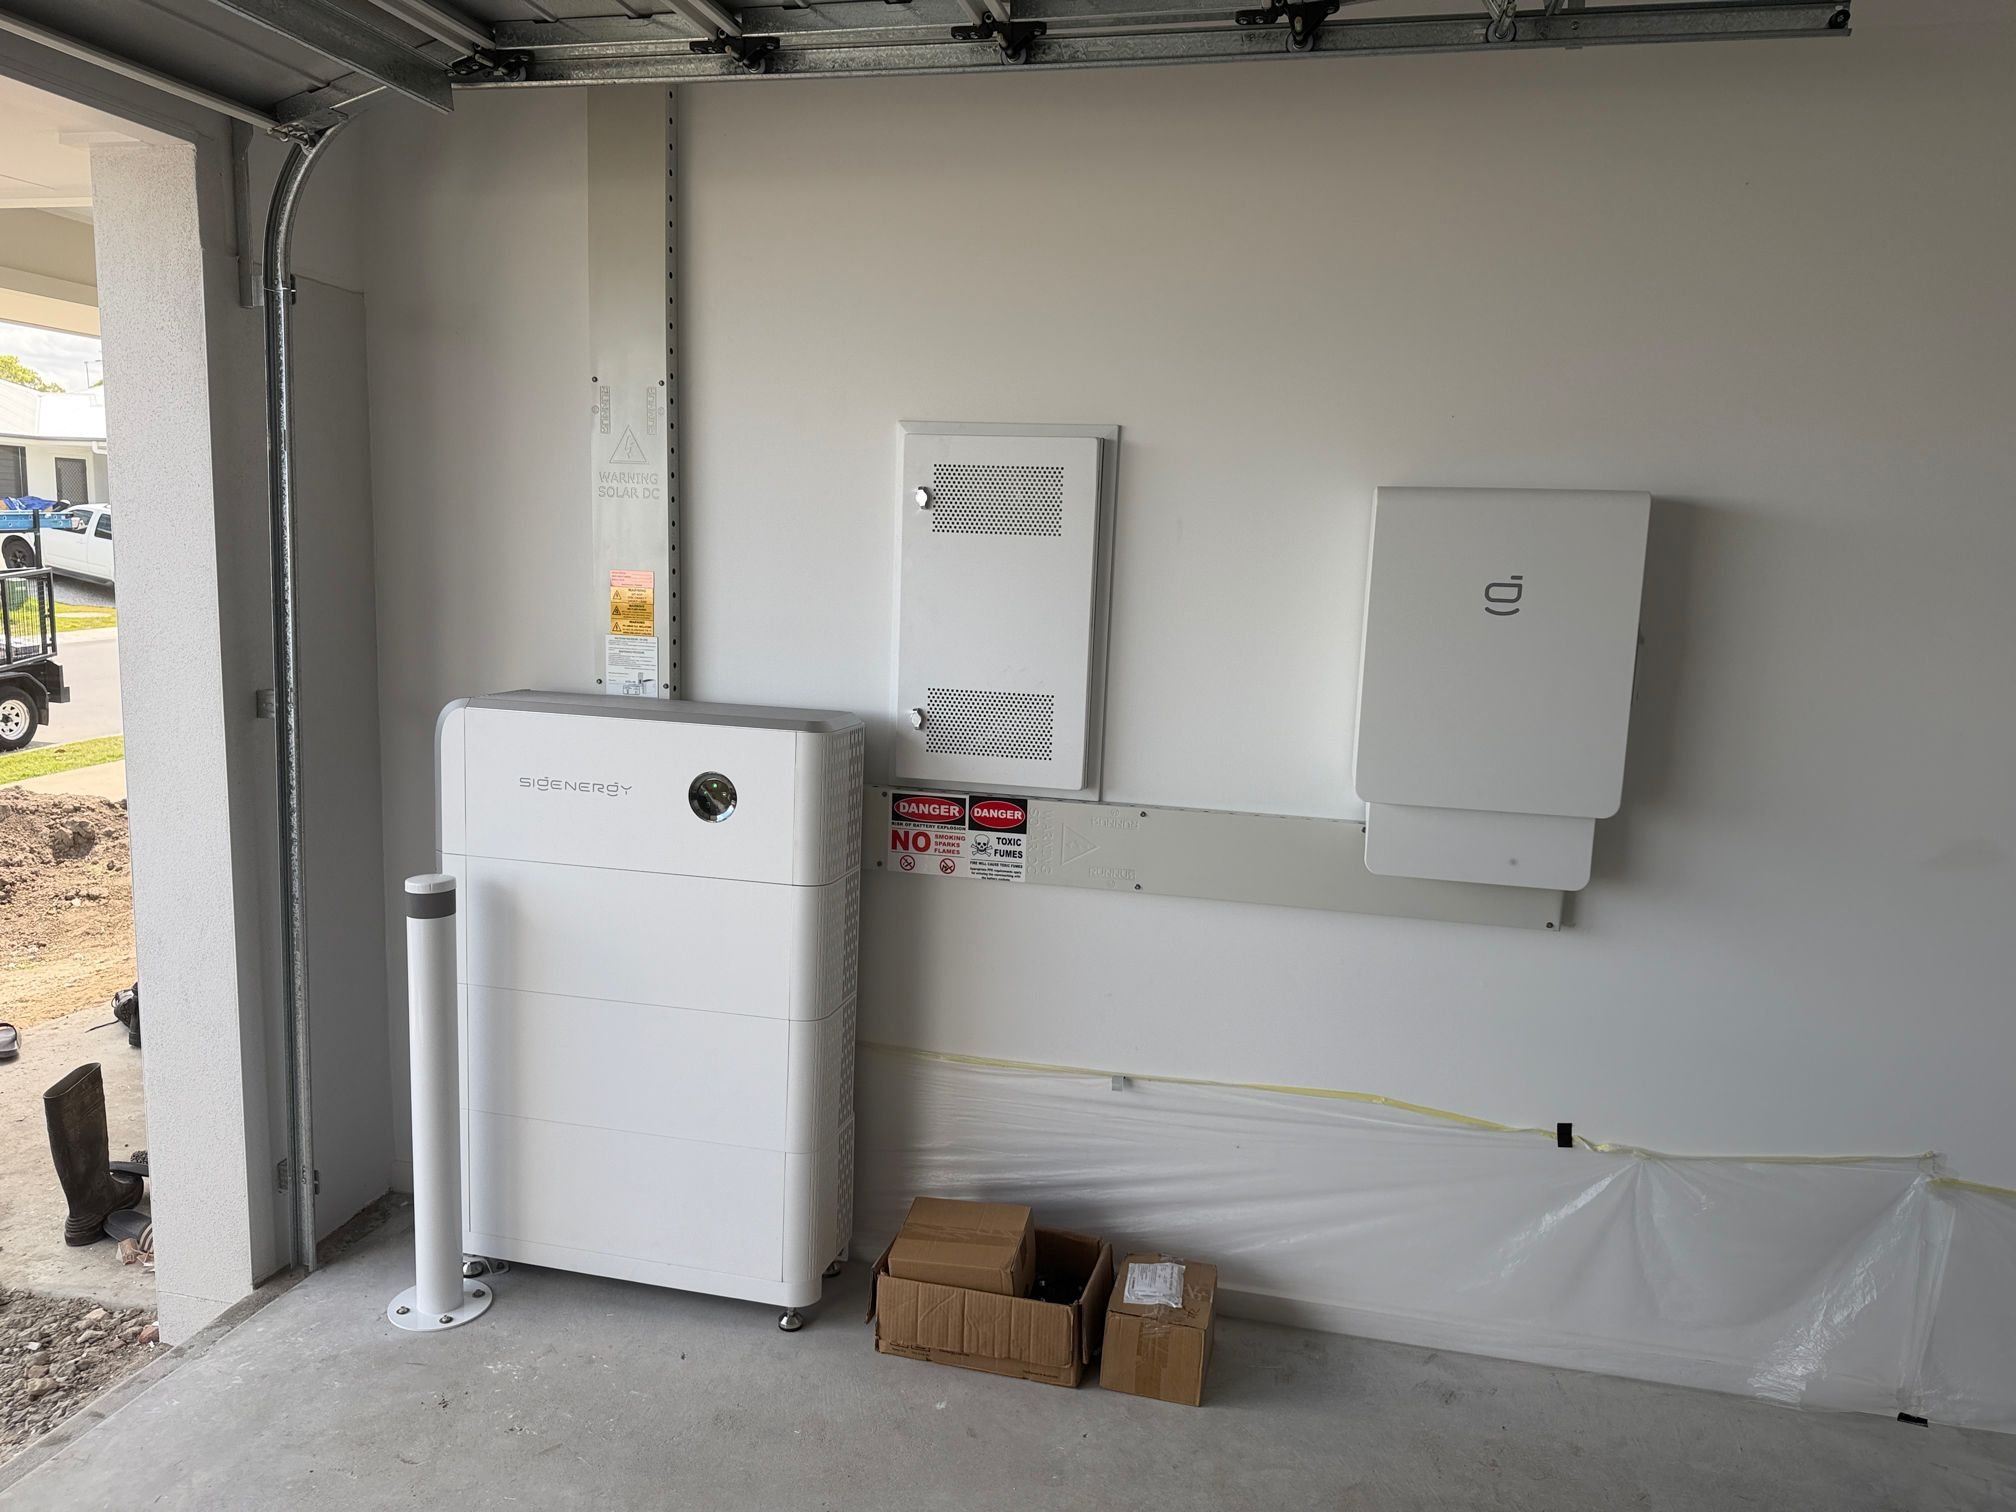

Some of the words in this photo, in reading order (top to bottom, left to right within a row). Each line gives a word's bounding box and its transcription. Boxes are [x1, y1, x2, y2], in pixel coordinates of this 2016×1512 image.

[599, 472, 659, 485] WARNING
[598, 486, 639, 499] SOLAR
[643, 487, 660, 500] DC
[899, 802, 960, 817] DANGER
[973, 807, 1022, 820] DANGER
[891, 830, 931, 852] NO
[996, 837, 1022, 847] TOXIC
[934, 847, 960, 855] FLAMES
[994, 848, 1023, 859] FUMES
